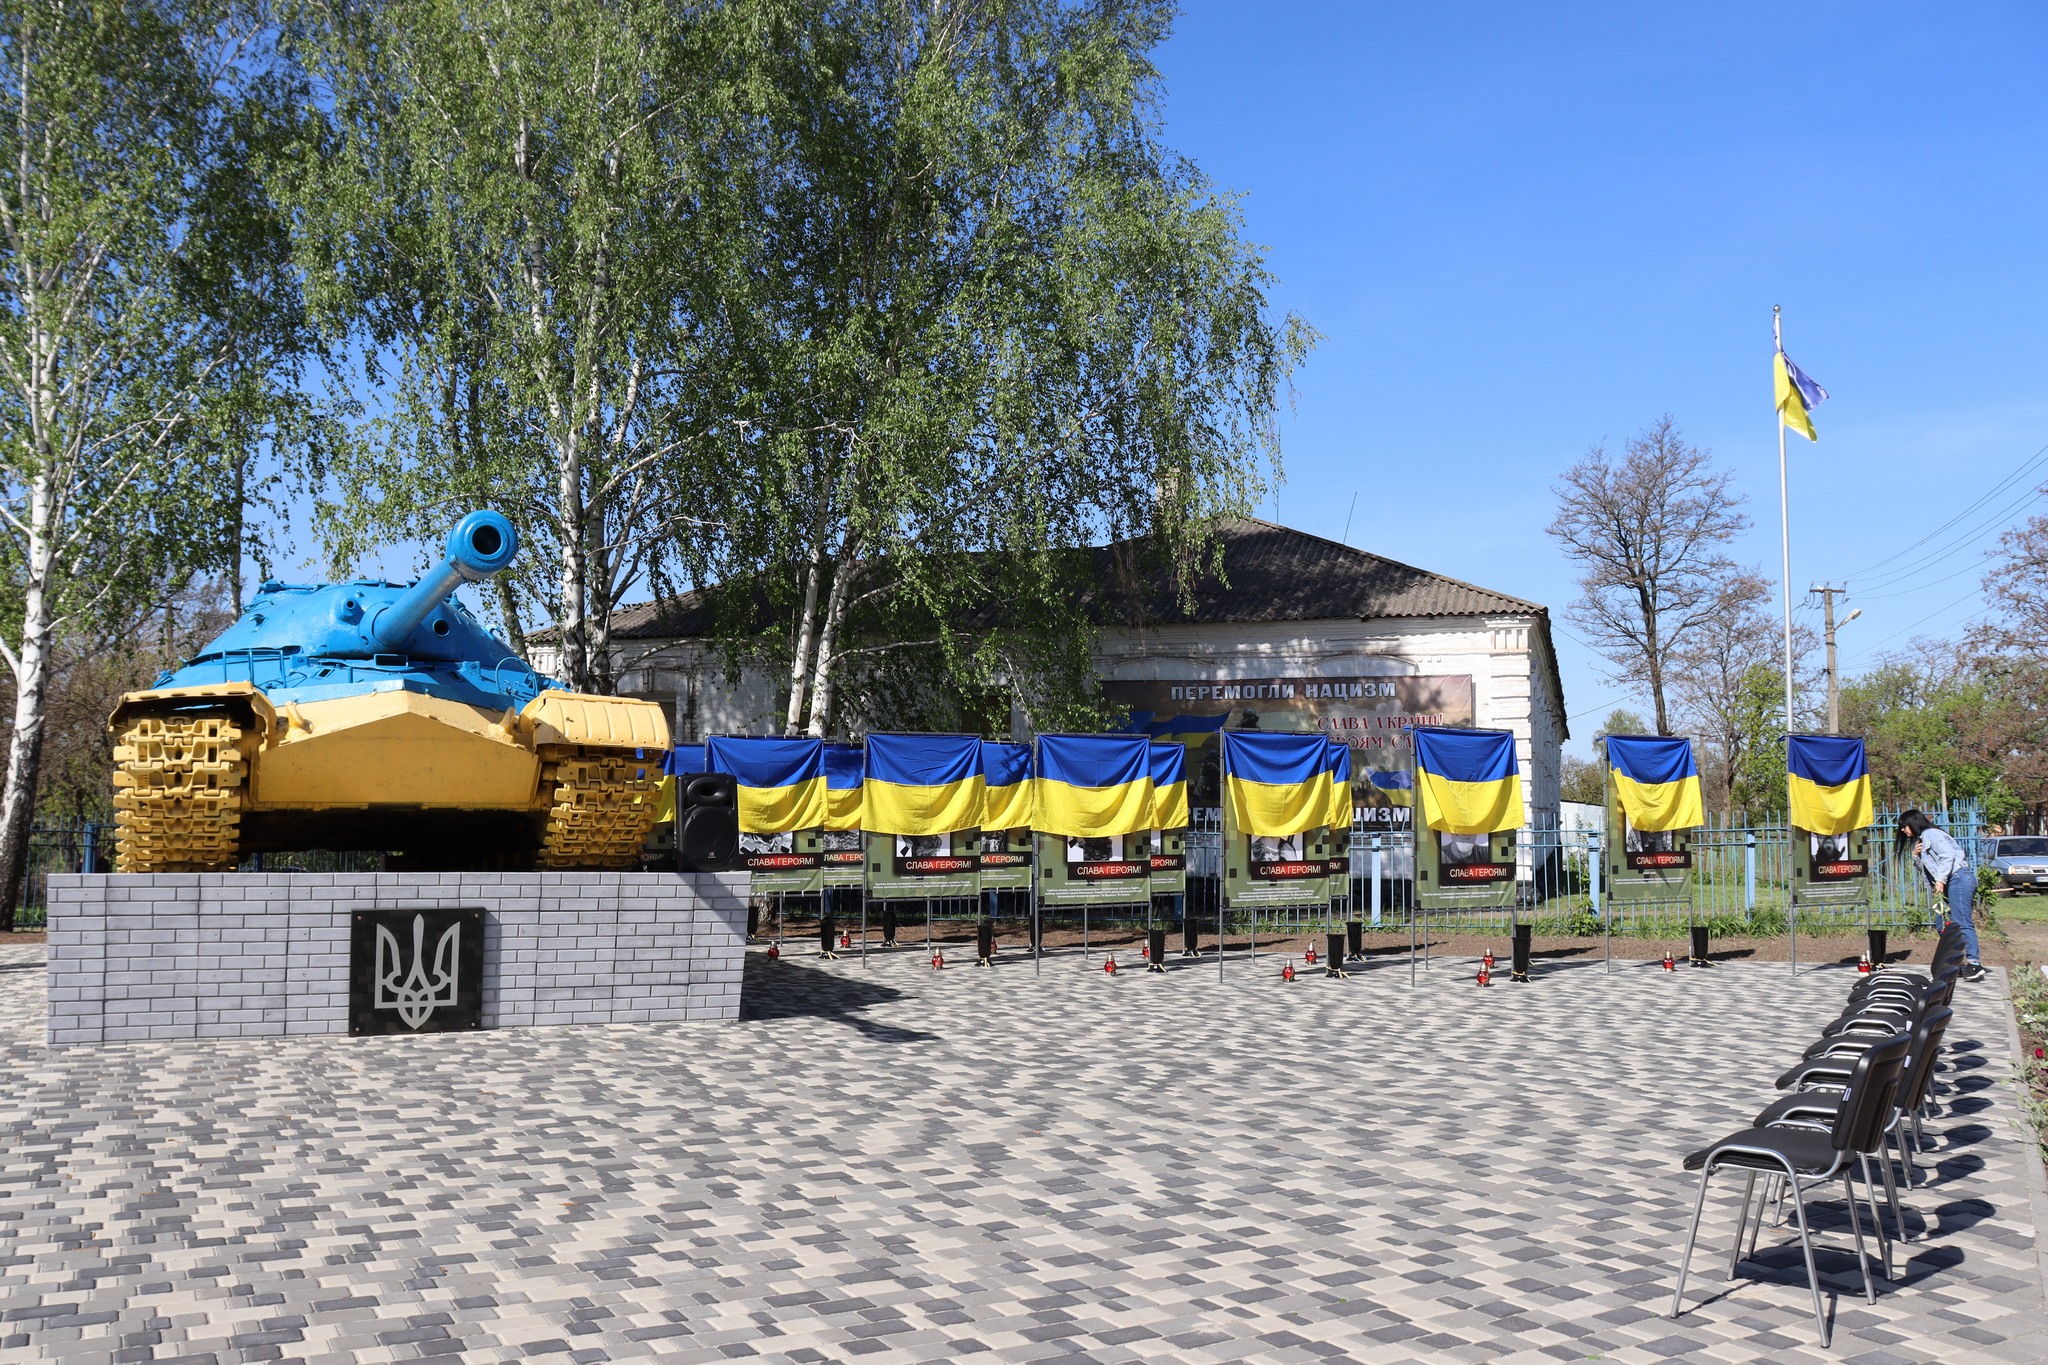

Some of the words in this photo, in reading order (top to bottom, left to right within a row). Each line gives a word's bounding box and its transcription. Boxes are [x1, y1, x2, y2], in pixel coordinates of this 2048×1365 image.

[1171, 684, 1295, 700] ПЕРЕМОГЛИ
[1305, 682, 1396, 701] НАЦИЗМ
[1317, 717, 1369, 730] СЛАВА
[747, 858, 775, 866] СЛАВА
[777, 857, 814, 866] ГЕРОЯМ!
[823, 854, 844, 862] ЛАВА
[845, 853, 864, 861] ГЕРО
[991, 855, 1024, 863] ГЕРОЯМ!
[1636, 856, 1657, 865] СЛАВА
[906, 861, 934, 869] СЛАВА
[935, 860, 972, 869] ГЕРОЯМ!
[1151, 859, 1178, 867] ЕРОЯМ!
[1077, 867, 1104, 875] СЛАВА
[1105, 865, 1142, 875] ГЕРОЯМ!
[1260, 866, 1286, 875] СЛАВА
[1287, 865, 1321, 874] ГЕРОЯМ!
[1449, 869, 1474, 878] СЛАВА
[1475, 868, 1507, 877] ГЕРОЯМ!
[1818, 865, 1837, 874] СЛАВА
[1837, 864, 1863, 873] ГЕРОЯМ!
